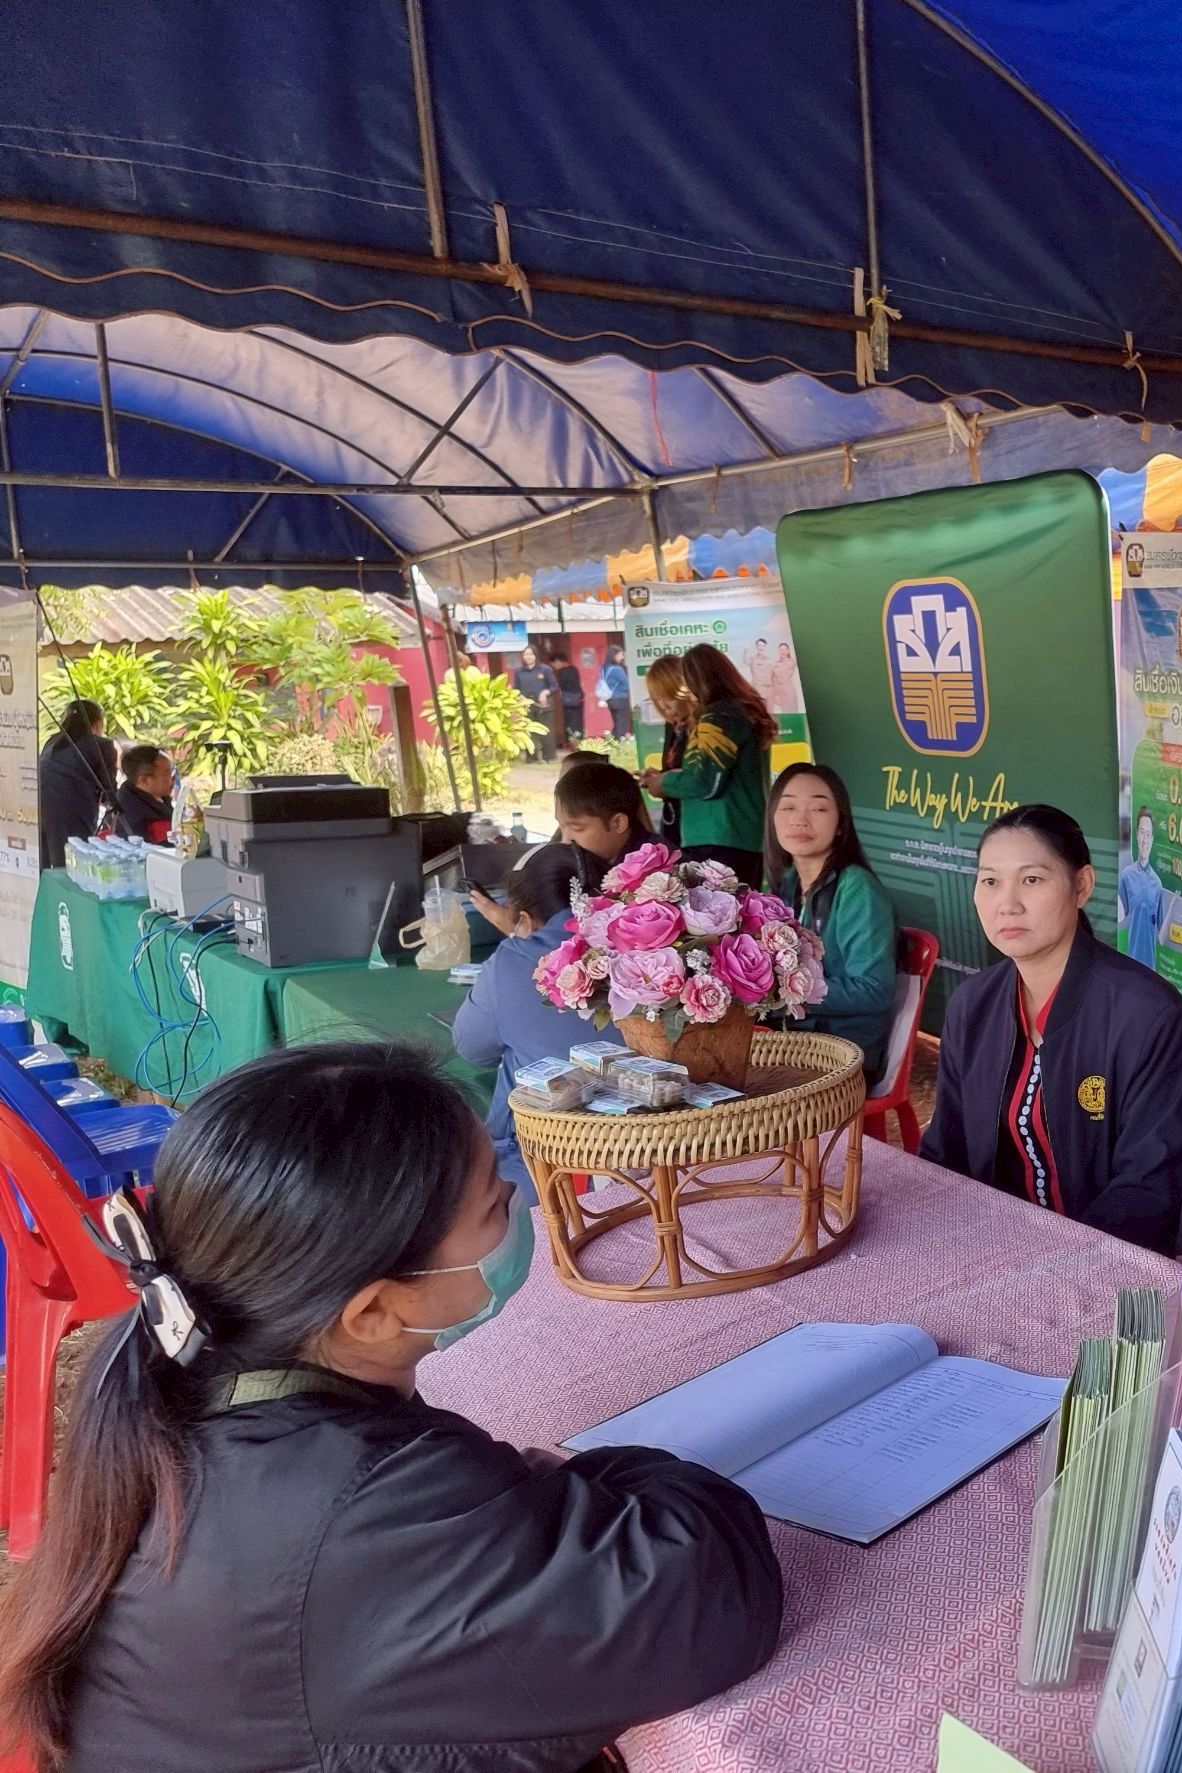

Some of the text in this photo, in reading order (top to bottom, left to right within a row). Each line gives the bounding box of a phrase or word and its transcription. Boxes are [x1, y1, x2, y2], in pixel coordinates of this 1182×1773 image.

[881, 766, 908, 811] The
[910, 769, 948, 830] Way
[951, 772, 980, 823] We
